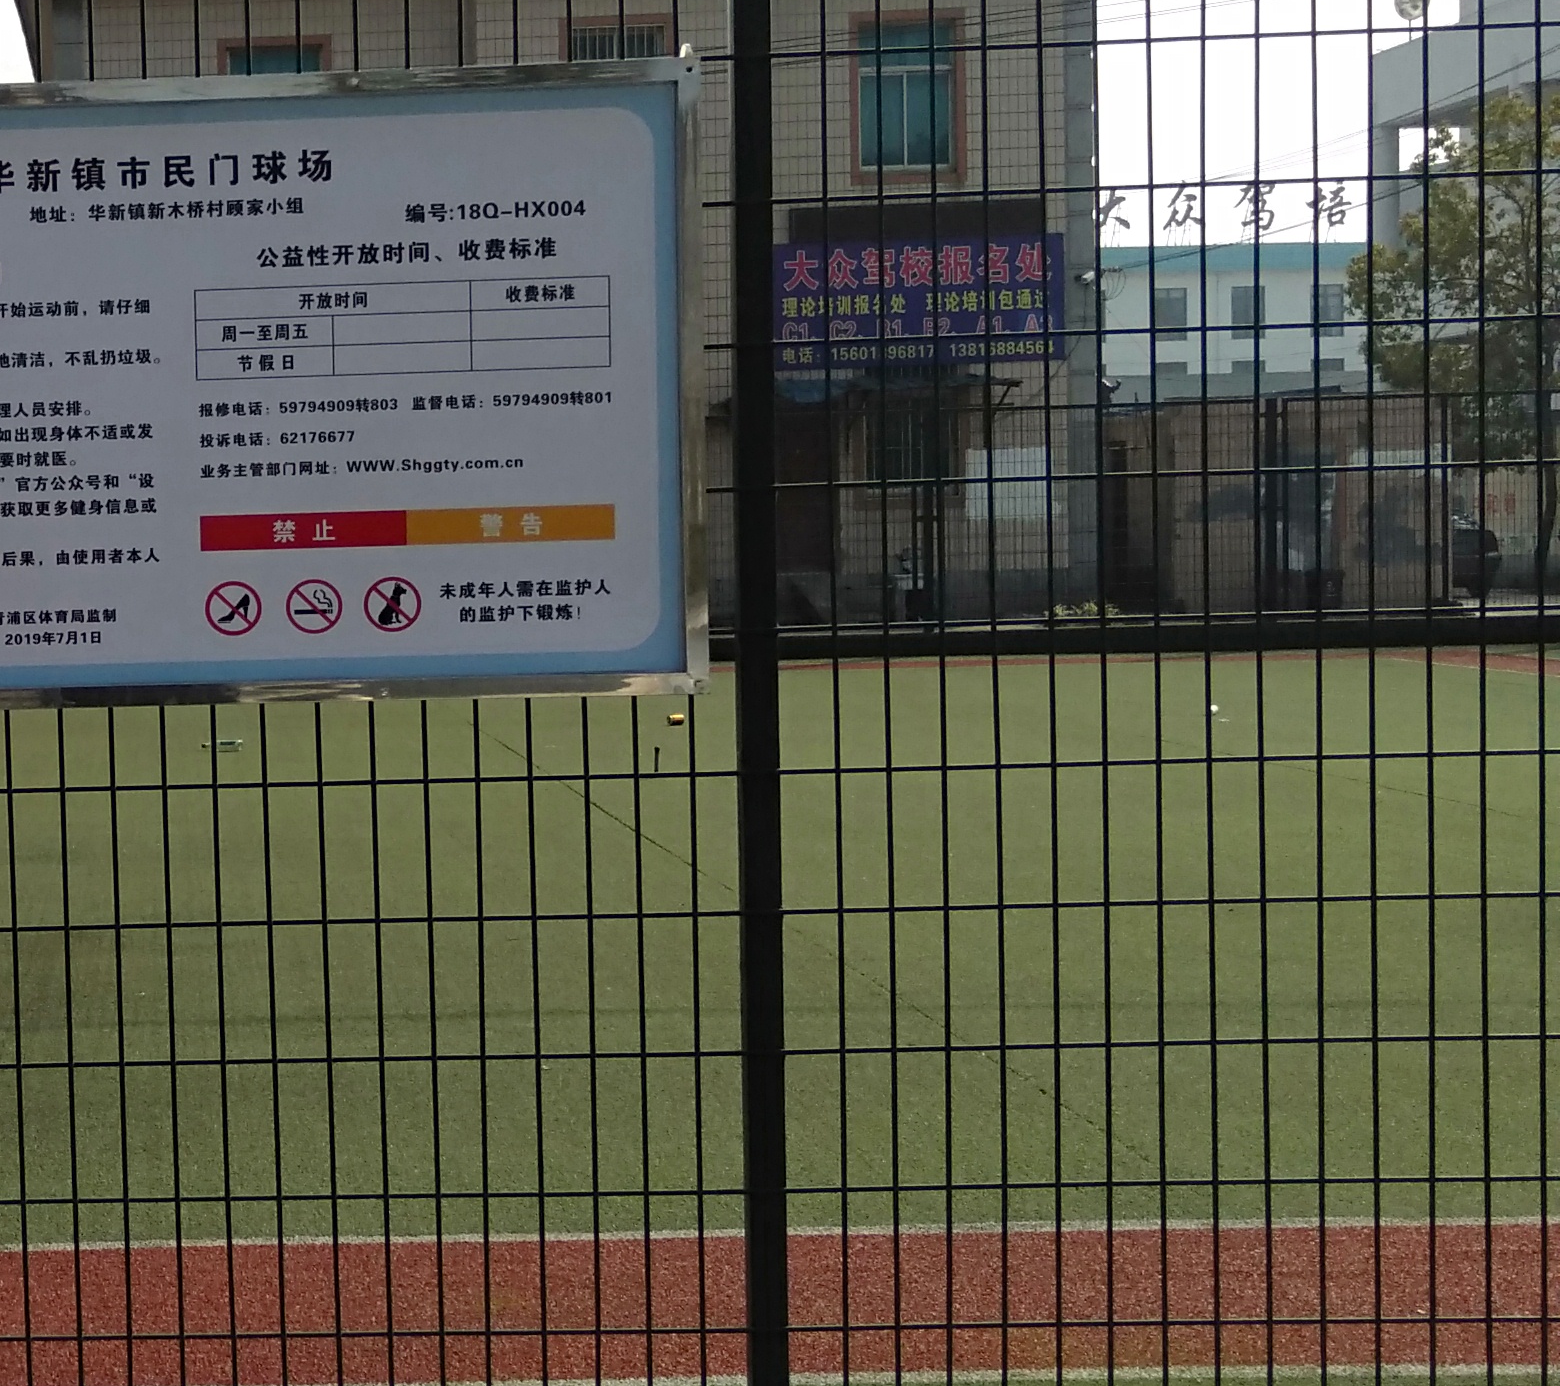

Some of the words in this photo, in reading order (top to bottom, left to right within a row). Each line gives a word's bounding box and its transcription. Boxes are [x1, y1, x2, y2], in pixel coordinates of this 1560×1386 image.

[29, 197, 305, 224] 地址：华新镇新木桥村顾家小组
[1096, 181, 1352, 231] 大众驾培
[256, 237, 558, 269] 公益性开放时间、收费标准
[783, 242, 1052, 292] 大众驾校报名处
[298, 292, 369, 310] 开放时间
[505, 284, 576, 304] 收费标准
[221, 323, 309, 343] 周一至周五
[237, 355, 295, 372] 节假日
[273, 519, 336, 543] 禁止
[479, 512, 542, 537] 警告
[440, 579, 611, 600] 未成年人需在监护人
[5, 631, 102, 646] 2019年7月1日
